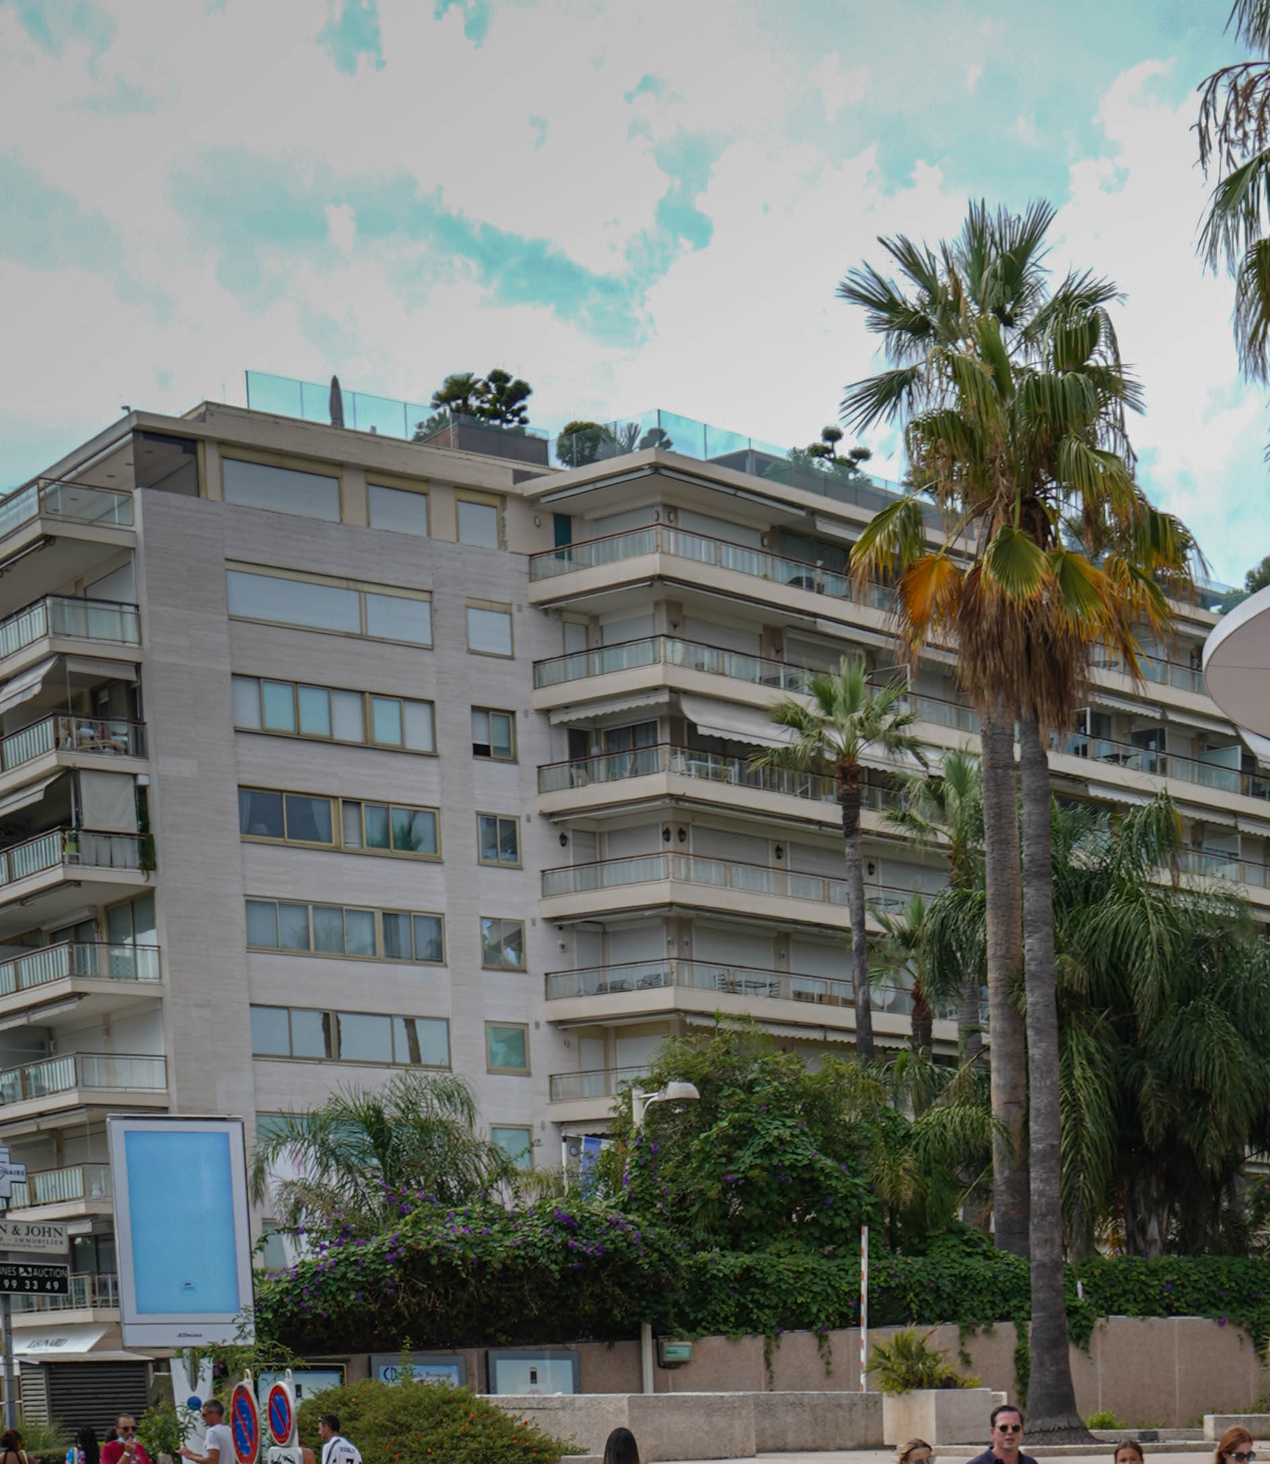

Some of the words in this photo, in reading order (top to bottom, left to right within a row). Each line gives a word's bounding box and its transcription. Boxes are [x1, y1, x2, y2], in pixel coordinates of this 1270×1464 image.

[24, 1226, 63, 1239] JOHN
[33, 1268, 68, 1279] AUCTION
[3, 1279, 18, 1289] 99
[25, 1280, 39, 1290] 33
